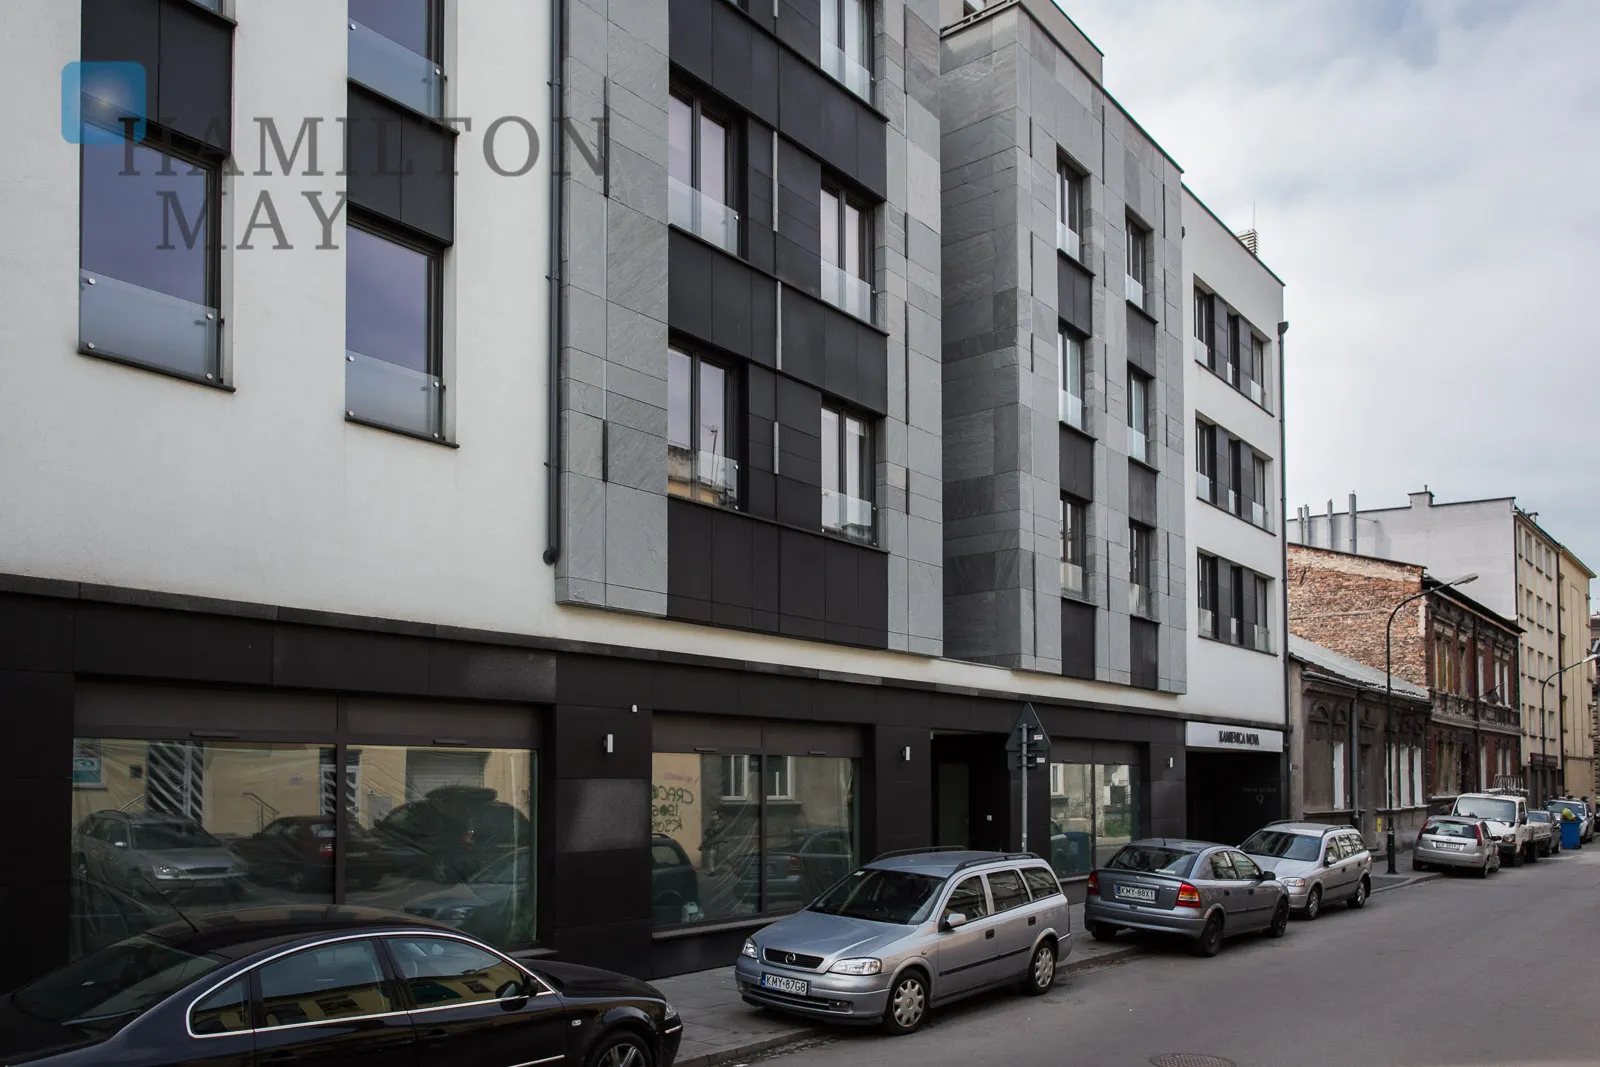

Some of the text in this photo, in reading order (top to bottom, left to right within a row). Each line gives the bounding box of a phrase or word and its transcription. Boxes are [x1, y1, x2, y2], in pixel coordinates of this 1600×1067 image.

[1121, 886, 1136, 896] KMY
[766, 975, 806, 993] KMY 87G8
